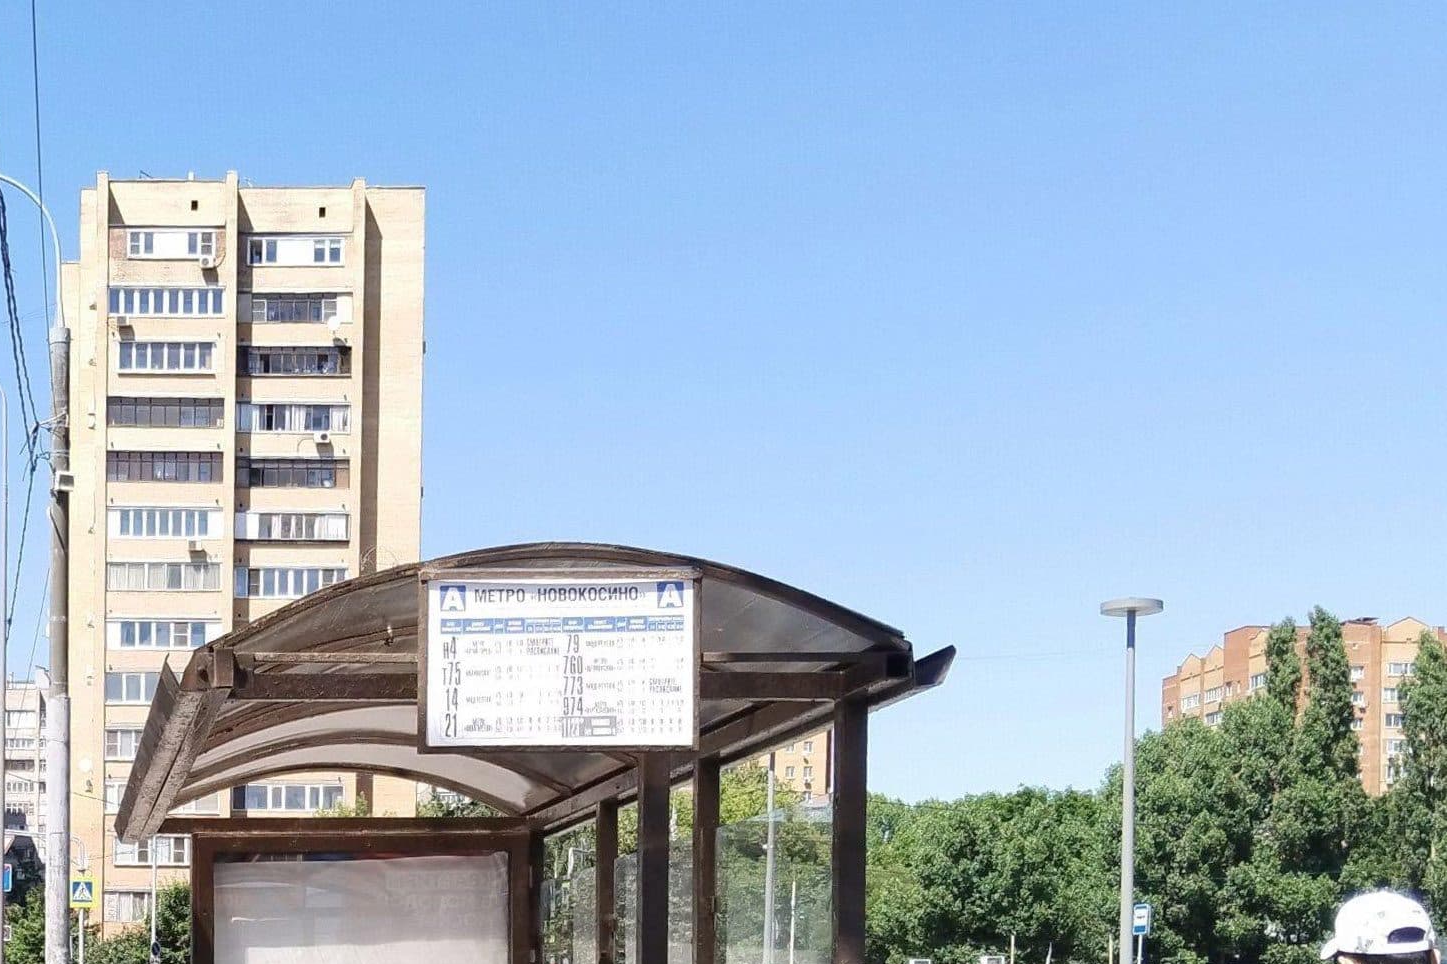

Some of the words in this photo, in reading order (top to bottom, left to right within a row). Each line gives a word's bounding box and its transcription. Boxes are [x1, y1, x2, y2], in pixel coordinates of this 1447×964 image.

[474, 588, 526, 603] МЕТРО
[567, 634, 580, 654] 79
[563, 676, 584, 696] 773
[446, 687, 459, 712] 14
[563, 696, 584, 716] 974
[445, 713, 458, 738] 21
